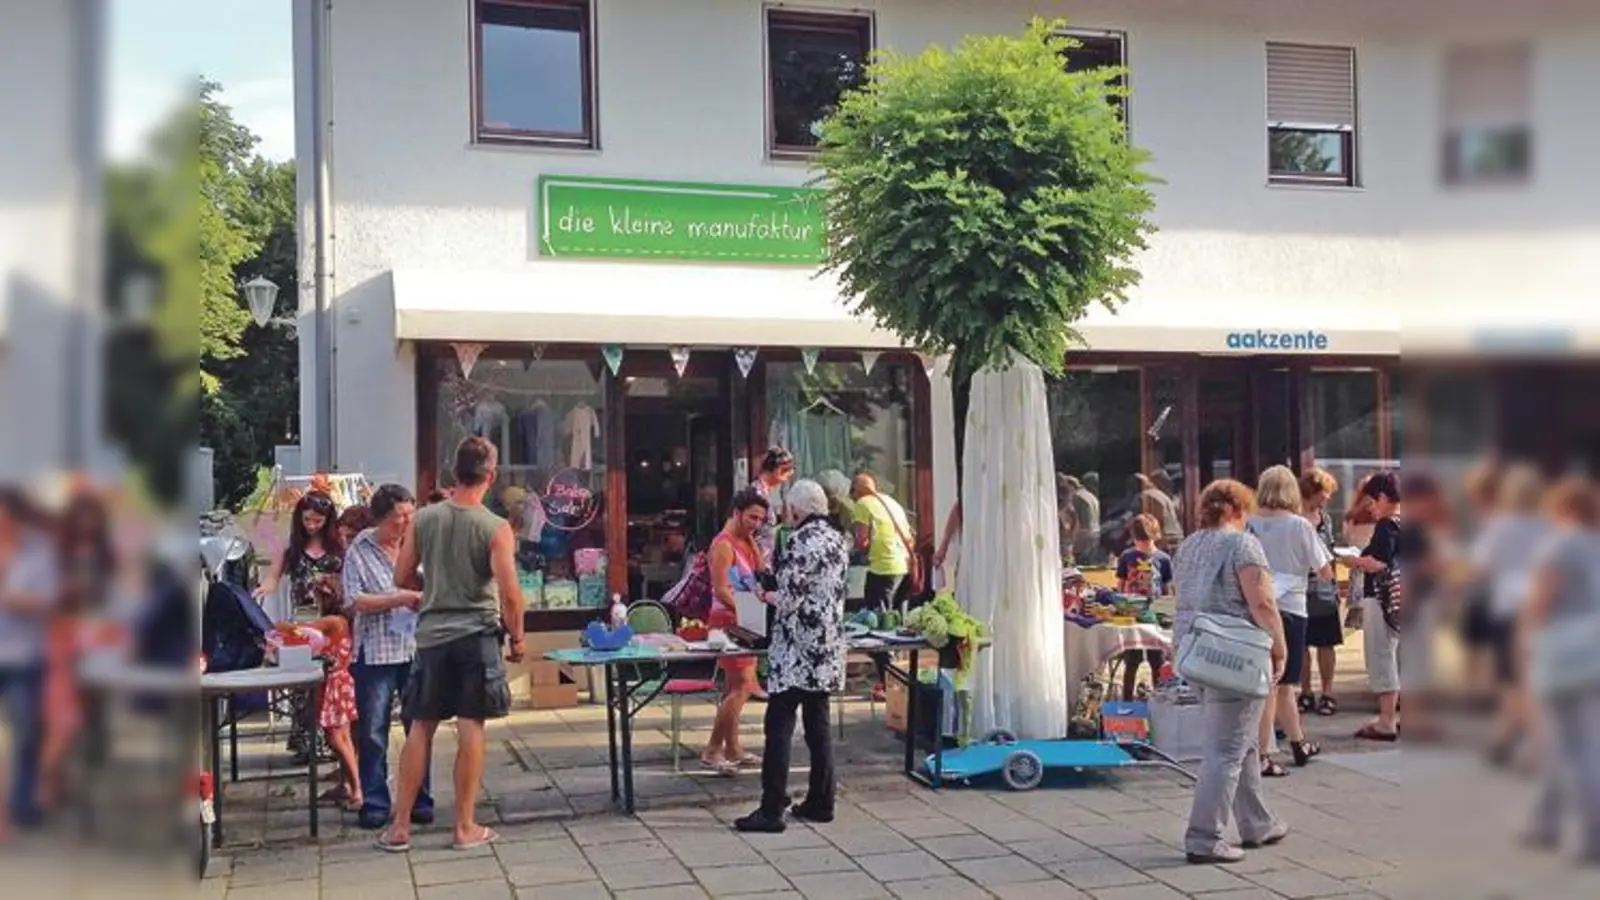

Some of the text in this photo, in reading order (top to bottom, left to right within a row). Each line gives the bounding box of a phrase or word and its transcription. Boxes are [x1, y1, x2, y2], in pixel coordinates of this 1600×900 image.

[559, 206, 813, 241] die kleine manufaktur
[1227, 329, 1328, 349] aakzente
